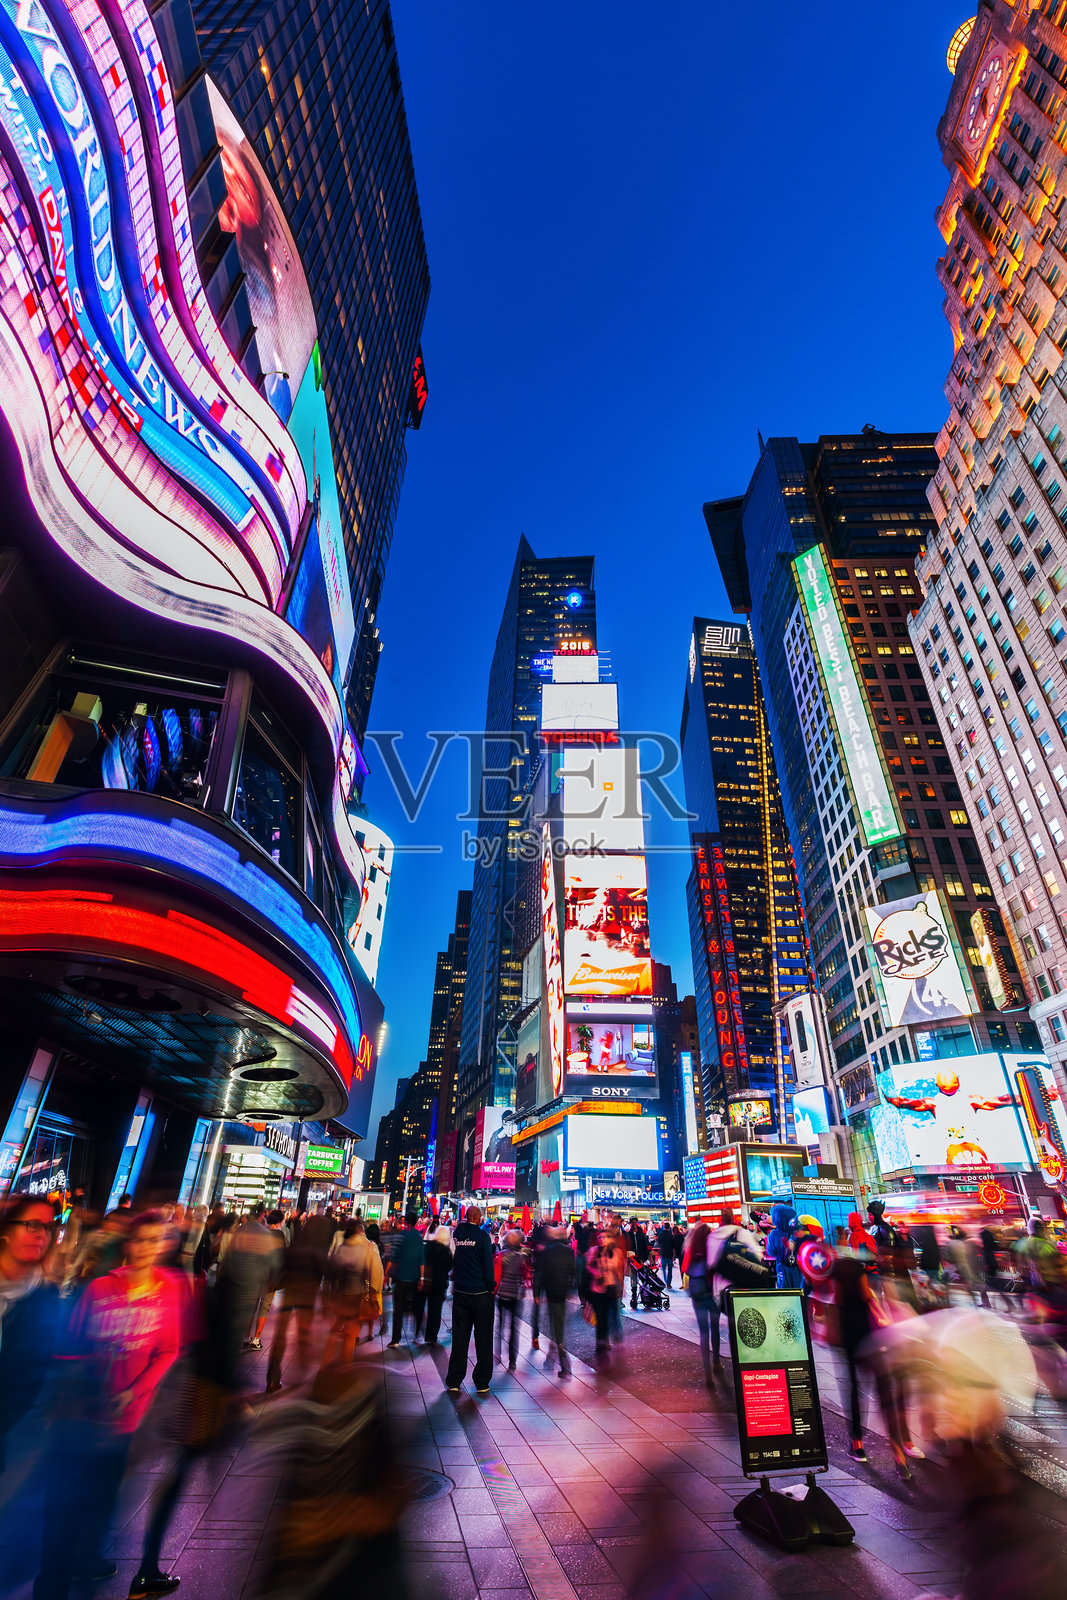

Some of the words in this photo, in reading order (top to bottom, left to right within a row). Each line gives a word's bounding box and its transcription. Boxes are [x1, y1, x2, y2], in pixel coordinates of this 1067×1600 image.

[803, 553, 828, 623] VOTED
[821, 622, 844, 682] BEST
[838, 684, 869, 771] BEACH
[861, 772, 886, 830] BAR
[541, 731, 619, 743] TOSHIBA
[697, 846, 714, 924] ERNST
[620, 905, 647, 921] THE
[708, 939, 720, 953] &
[882, 950, 946, 976] CAFE
[575, 967, 641, 981] Budweiser
[712, 970, 735, 1068] YOUNG
[592, 1087, 631, 1097] SONY
[307, 1149, 343, 1160] TARBUCKS
[308, 1158, 334, 1168] COFFEE
[484, 1165, 501, 1173] WE'LL
[501, 1165, 512, 1173] PAY
[483, 1172, 514, 1180] SWITCHING
[592, 1186, 611, 1199] NEW
[611, 1186, 634, 1200] YORK
[634, 1187, 664, 1200] POLICE
